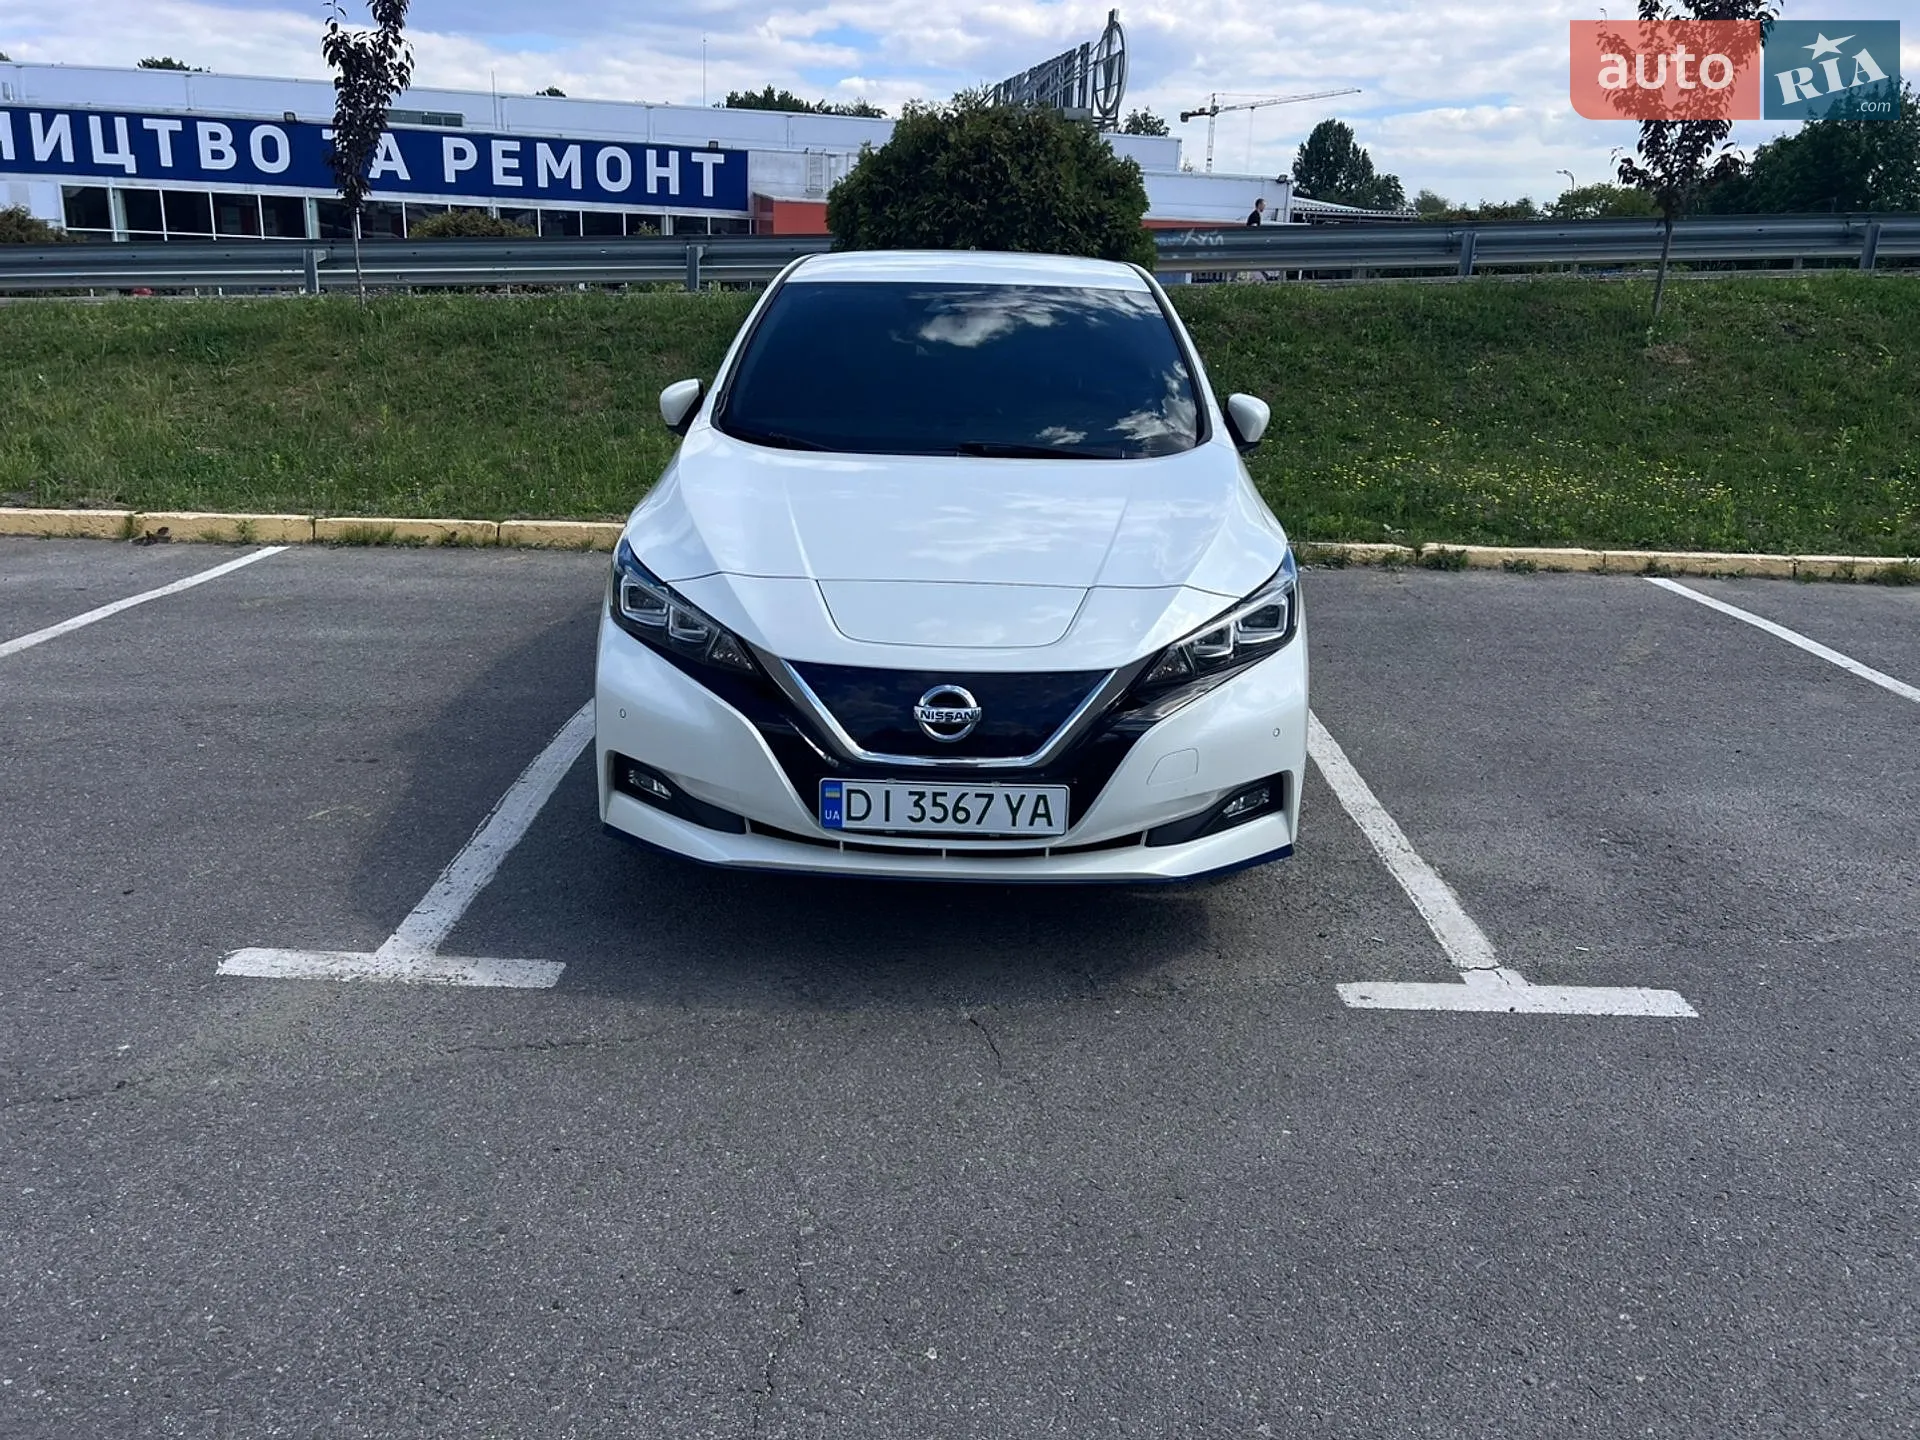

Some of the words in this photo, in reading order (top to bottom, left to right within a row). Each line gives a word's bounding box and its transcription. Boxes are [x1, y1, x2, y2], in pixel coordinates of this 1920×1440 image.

[322, 129, 411, 180] А
[442, 136, 725, 198] РЕМОНТ
[920, 709, 975, 720] NISSAN
[824, 810, 840, 821] UA
[846, 788, 892, 823] DI
[907, 790, 995, 825] 3567
[1004, 793, 1053, 827] YA
